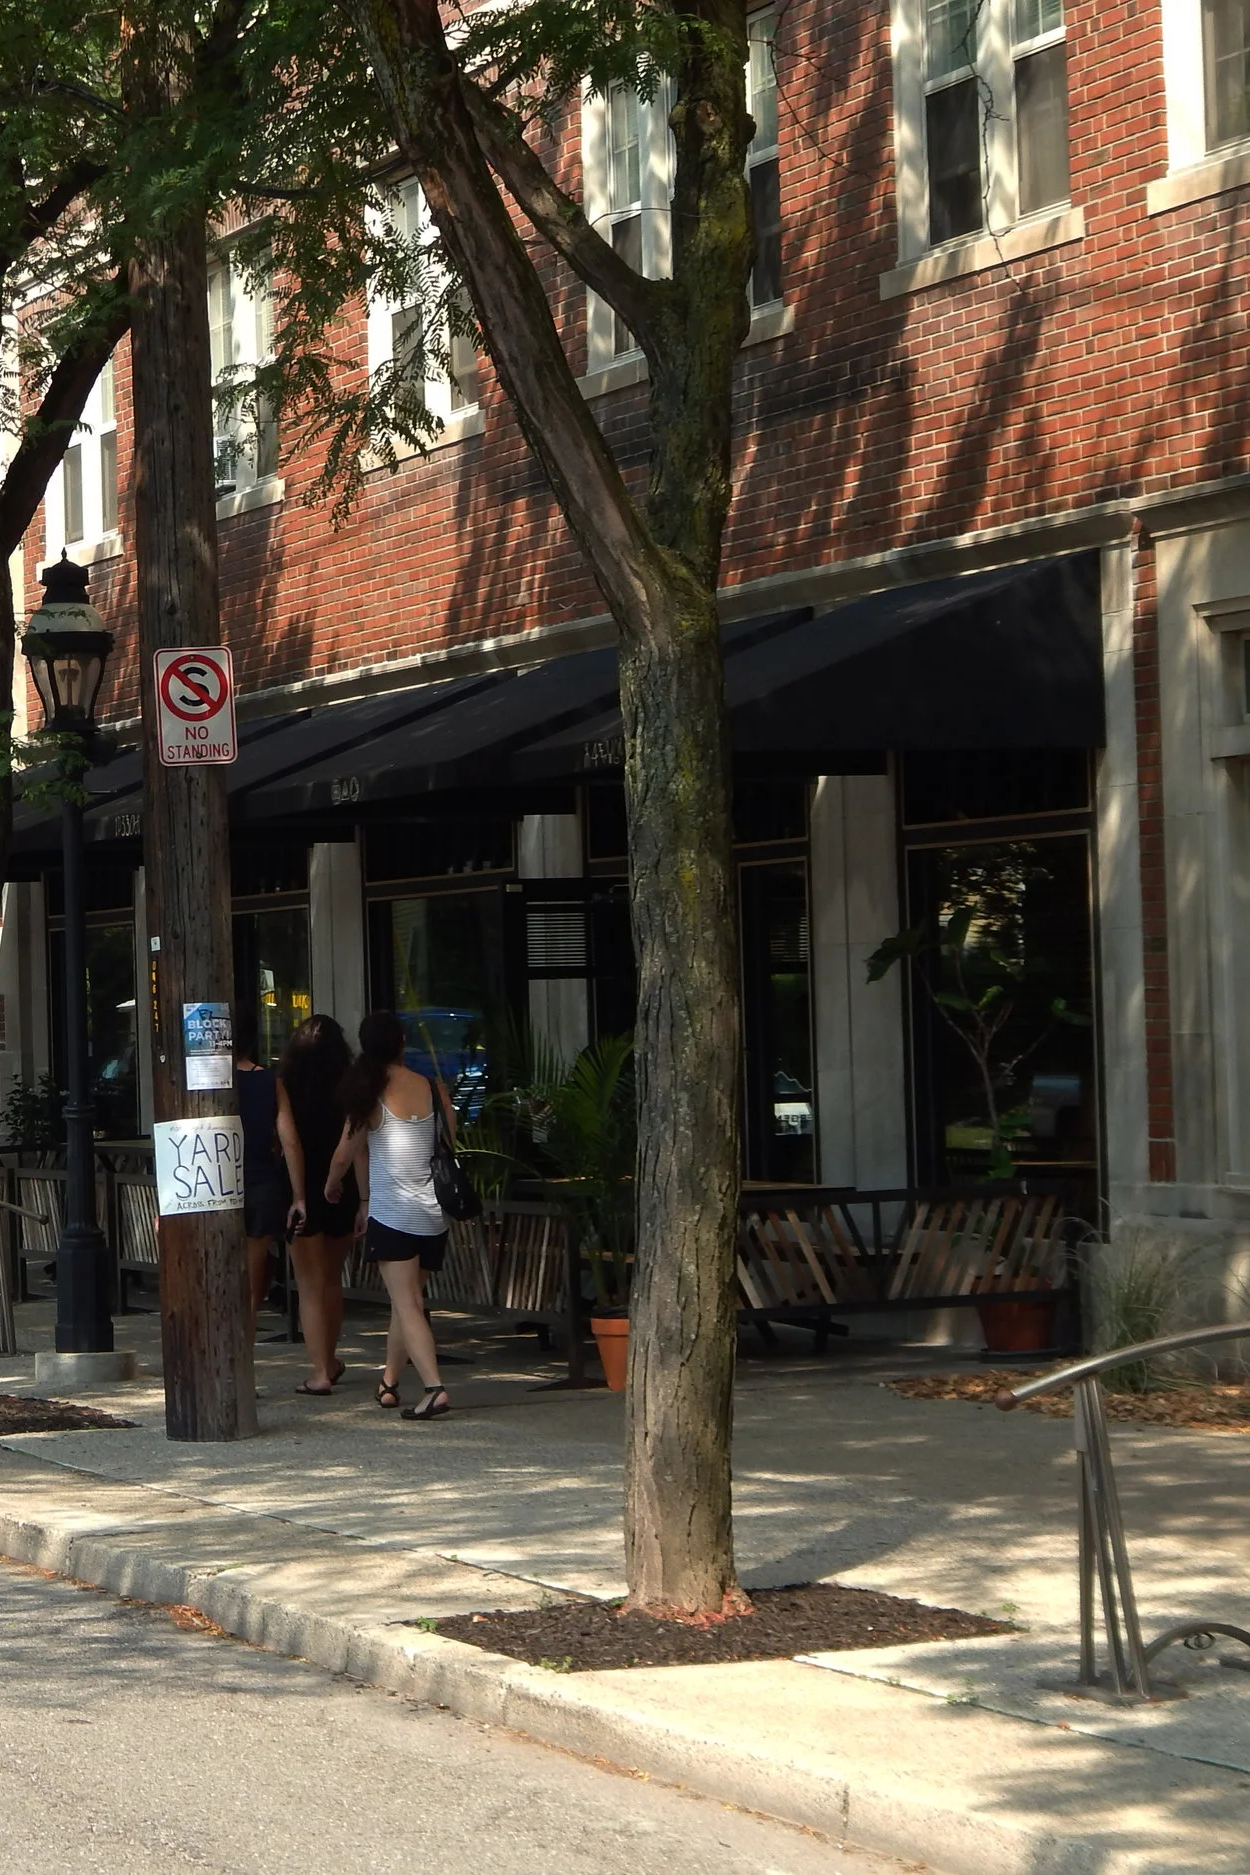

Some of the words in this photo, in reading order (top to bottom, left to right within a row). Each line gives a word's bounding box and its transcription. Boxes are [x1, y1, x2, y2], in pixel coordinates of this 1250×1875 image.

[185, 726, 209, 740] NO
[167, 743, 230, 760] STANDING
[187, 1019, 227, 1029] BLOCK
[168, 1132, 242, 1167] YARD
[173, 1163, 244, 1199] SALE
[177, 1201, 205, 1211] ACROSS
[207, 1198, 226, 1208] FROM
